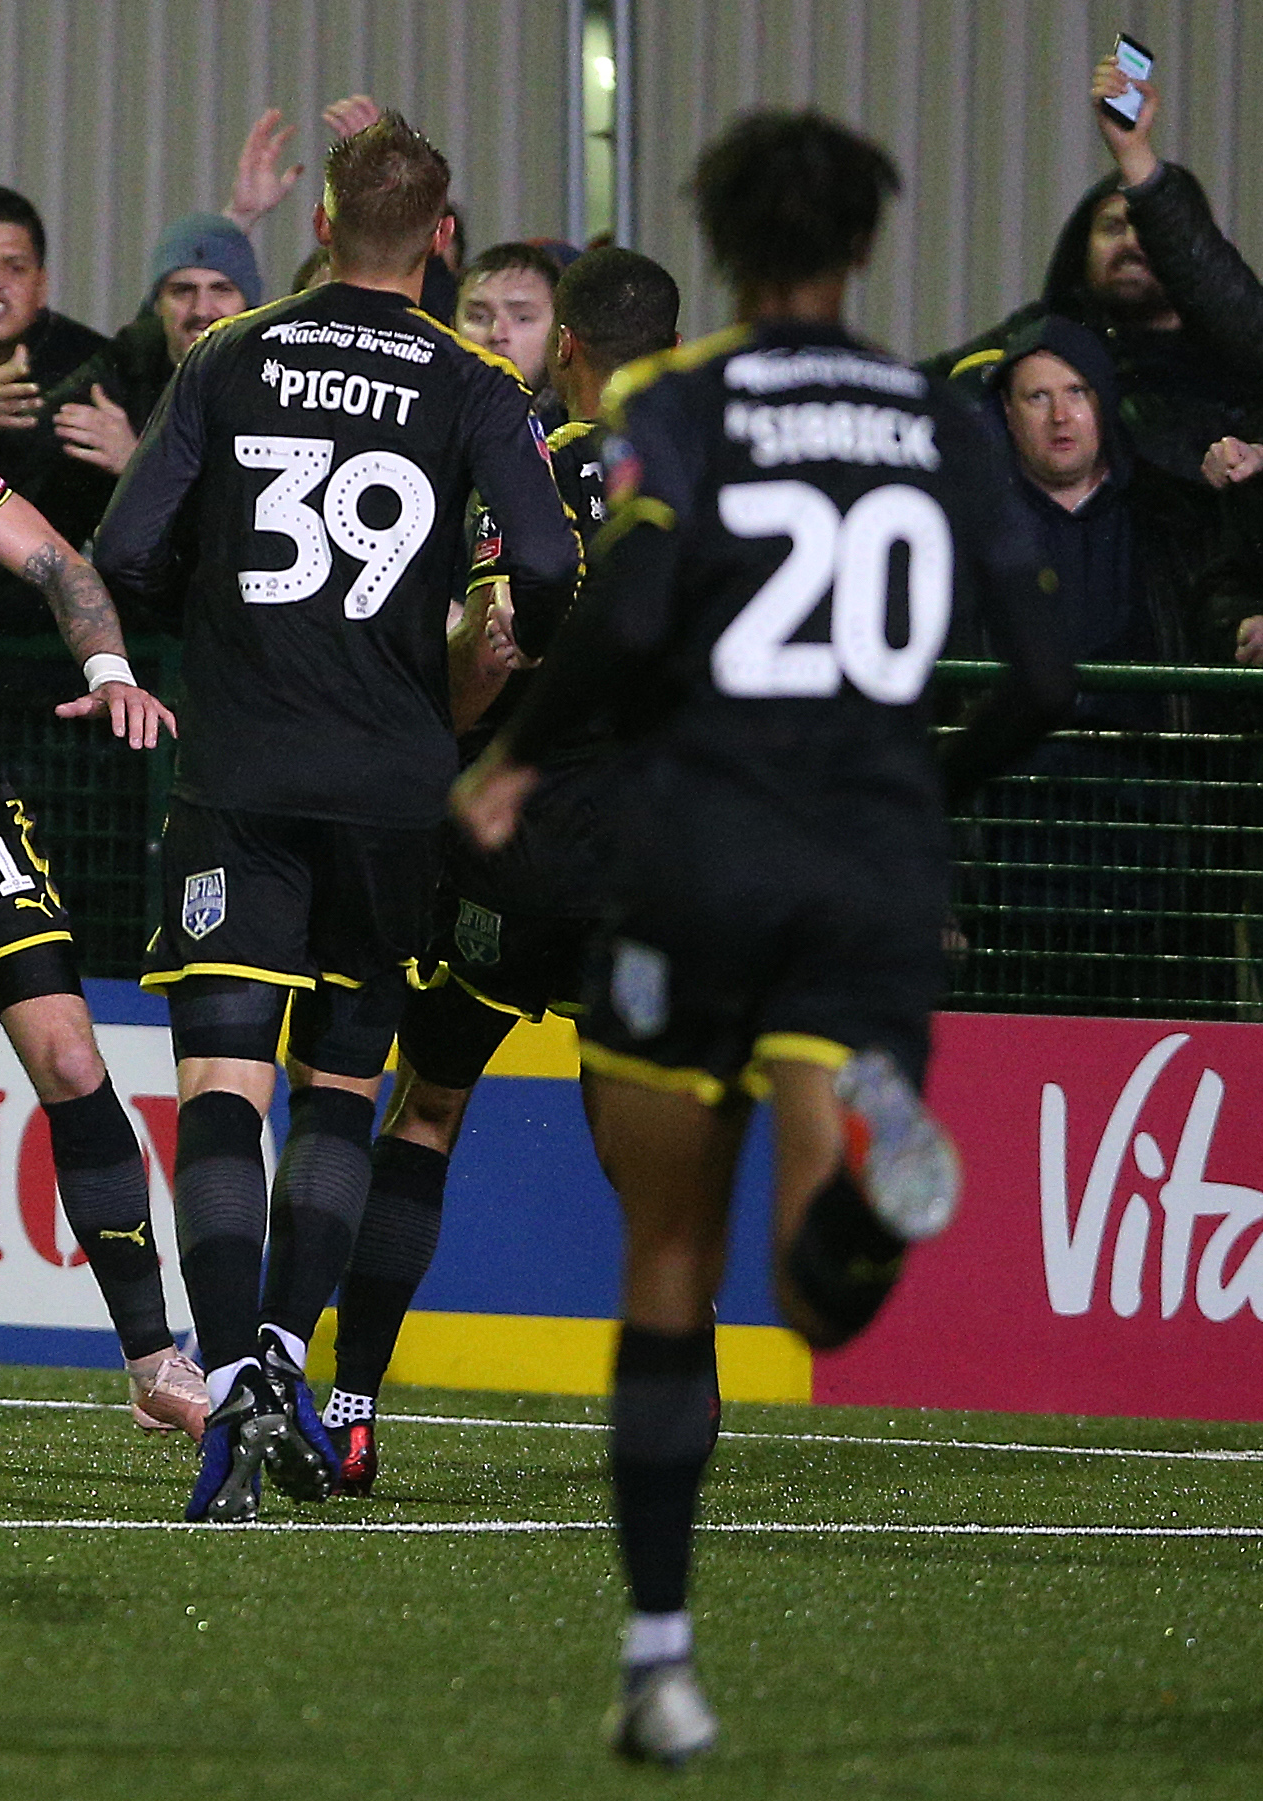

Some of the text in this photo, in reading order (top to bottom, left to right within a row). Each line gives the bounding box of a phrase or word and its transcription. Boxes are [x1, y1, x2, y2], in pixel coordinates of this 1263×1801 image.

[279, 324, 434, 365] Racing Breaks
[279, 369, 421, 427] PIGOTT
[234, 435, 436, 620] 39
[710, 479, 955, 706] 20
[1039, 1032, 1263, 1322] Vita
